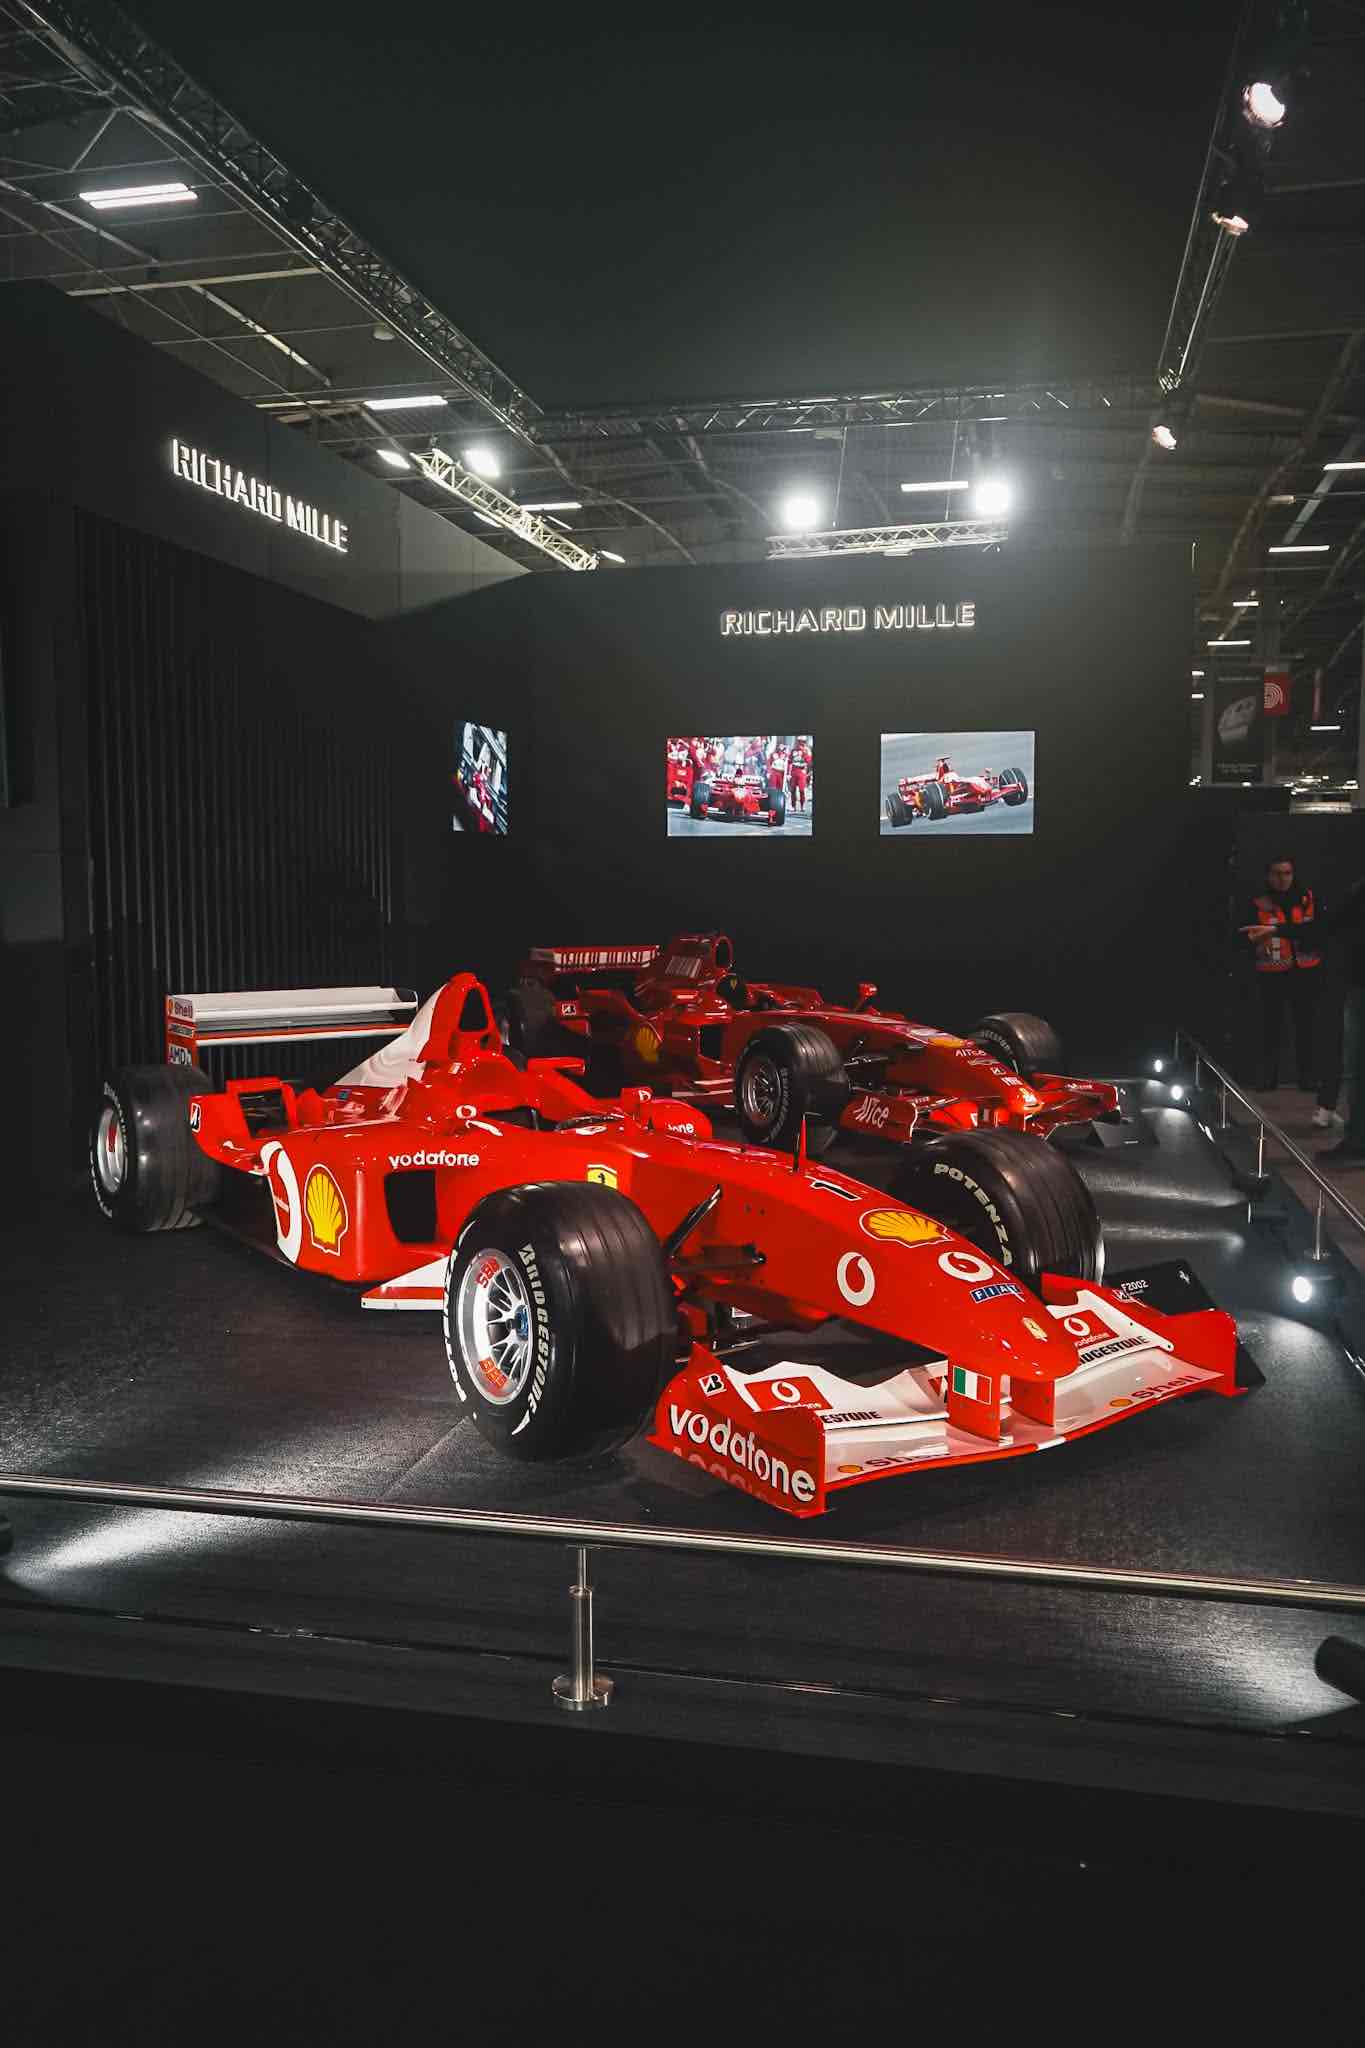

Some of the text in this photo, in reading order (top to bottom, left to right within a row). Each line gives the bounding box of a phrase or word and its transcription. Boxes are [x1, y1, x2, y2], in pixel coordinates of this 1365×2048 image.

[172, 437, 348, 552] RICHARD MILLE
[720, 600, 976, 636] RICHARD MILLE
[388, 1150, 480, 1169] vodafone
[933, 1162, 1014, 1267] POTENZA
[973, 1283, 1021, 1302] FIAT
[1120, 1279, 1149, 1297] F2002
[517, 1242, 549, 1416] BRIDGESTONE
[669, 1403, 816, 1503] vodafone
